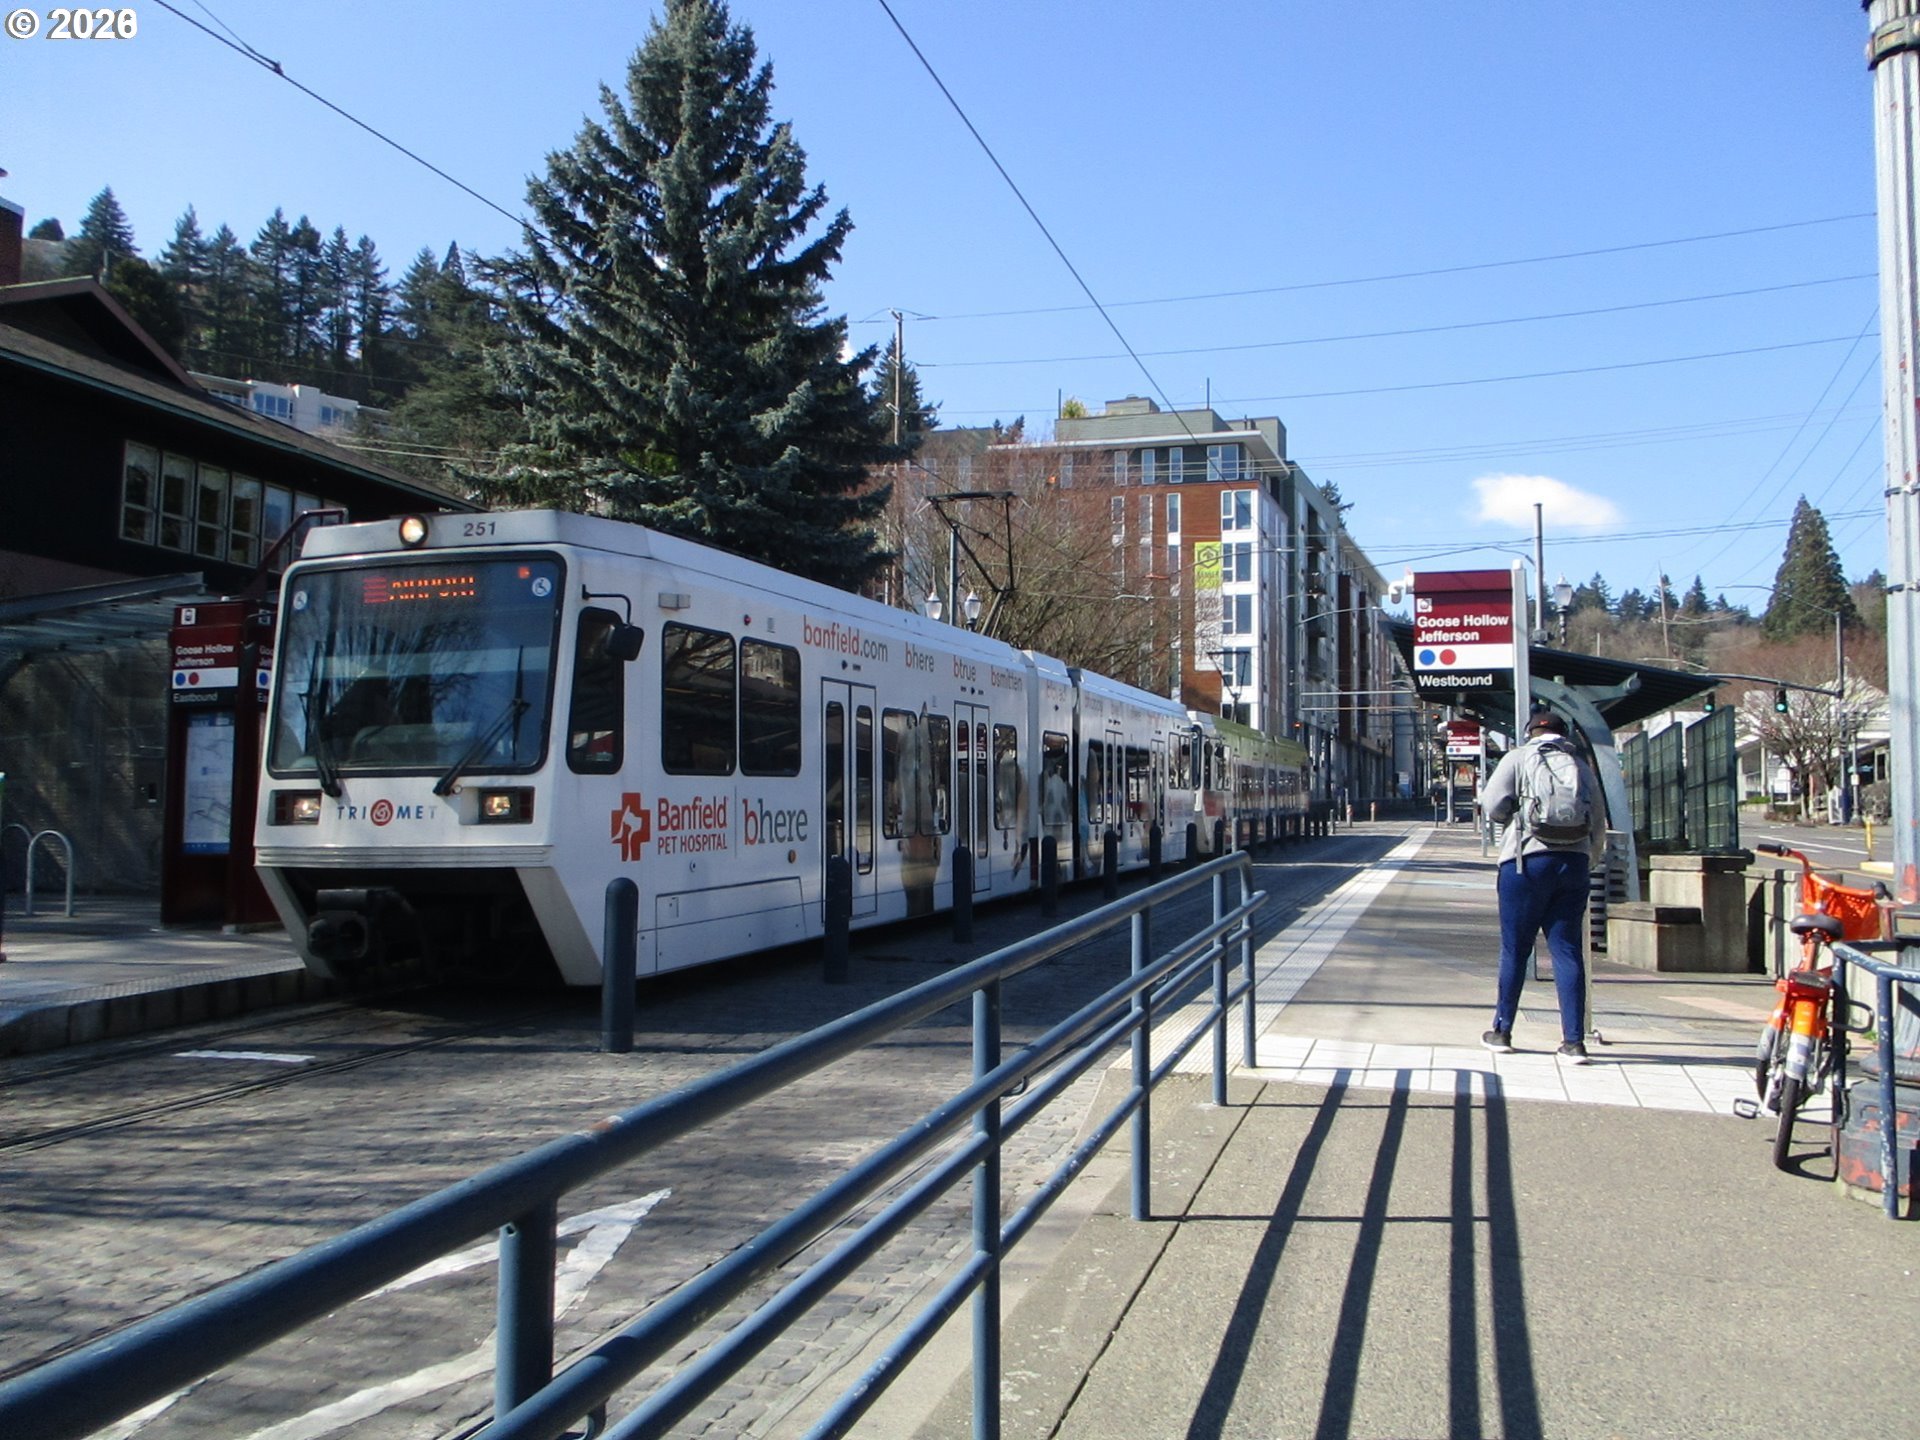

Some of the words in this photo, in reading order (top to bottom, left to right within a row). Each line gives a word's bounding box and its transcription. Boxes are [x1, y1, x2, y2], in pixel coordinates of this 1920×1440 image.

[463, 521, 497, 537] 251
[1417, 616, 1460, 628] Goose
[1463, 614, 1509, 627] Hollow
[1417, 630, 1480, 643] Jefferson
[175, 645, 203, 655] Goose
[205, 644, 234, 654] Hollow
[803, 614, 888, 662] banfield.com
[904, 641, 935, 672] bhere
[953, 654, 977, 682] btrue
[1418, 674, 1493, 687] Westbound
[658, 796, 728, 831] Banfield
[742, 798, 808, 846] bhere
[657, 836, 678, 855] PET
[680, 833, 728, 853] HOSPITAL
